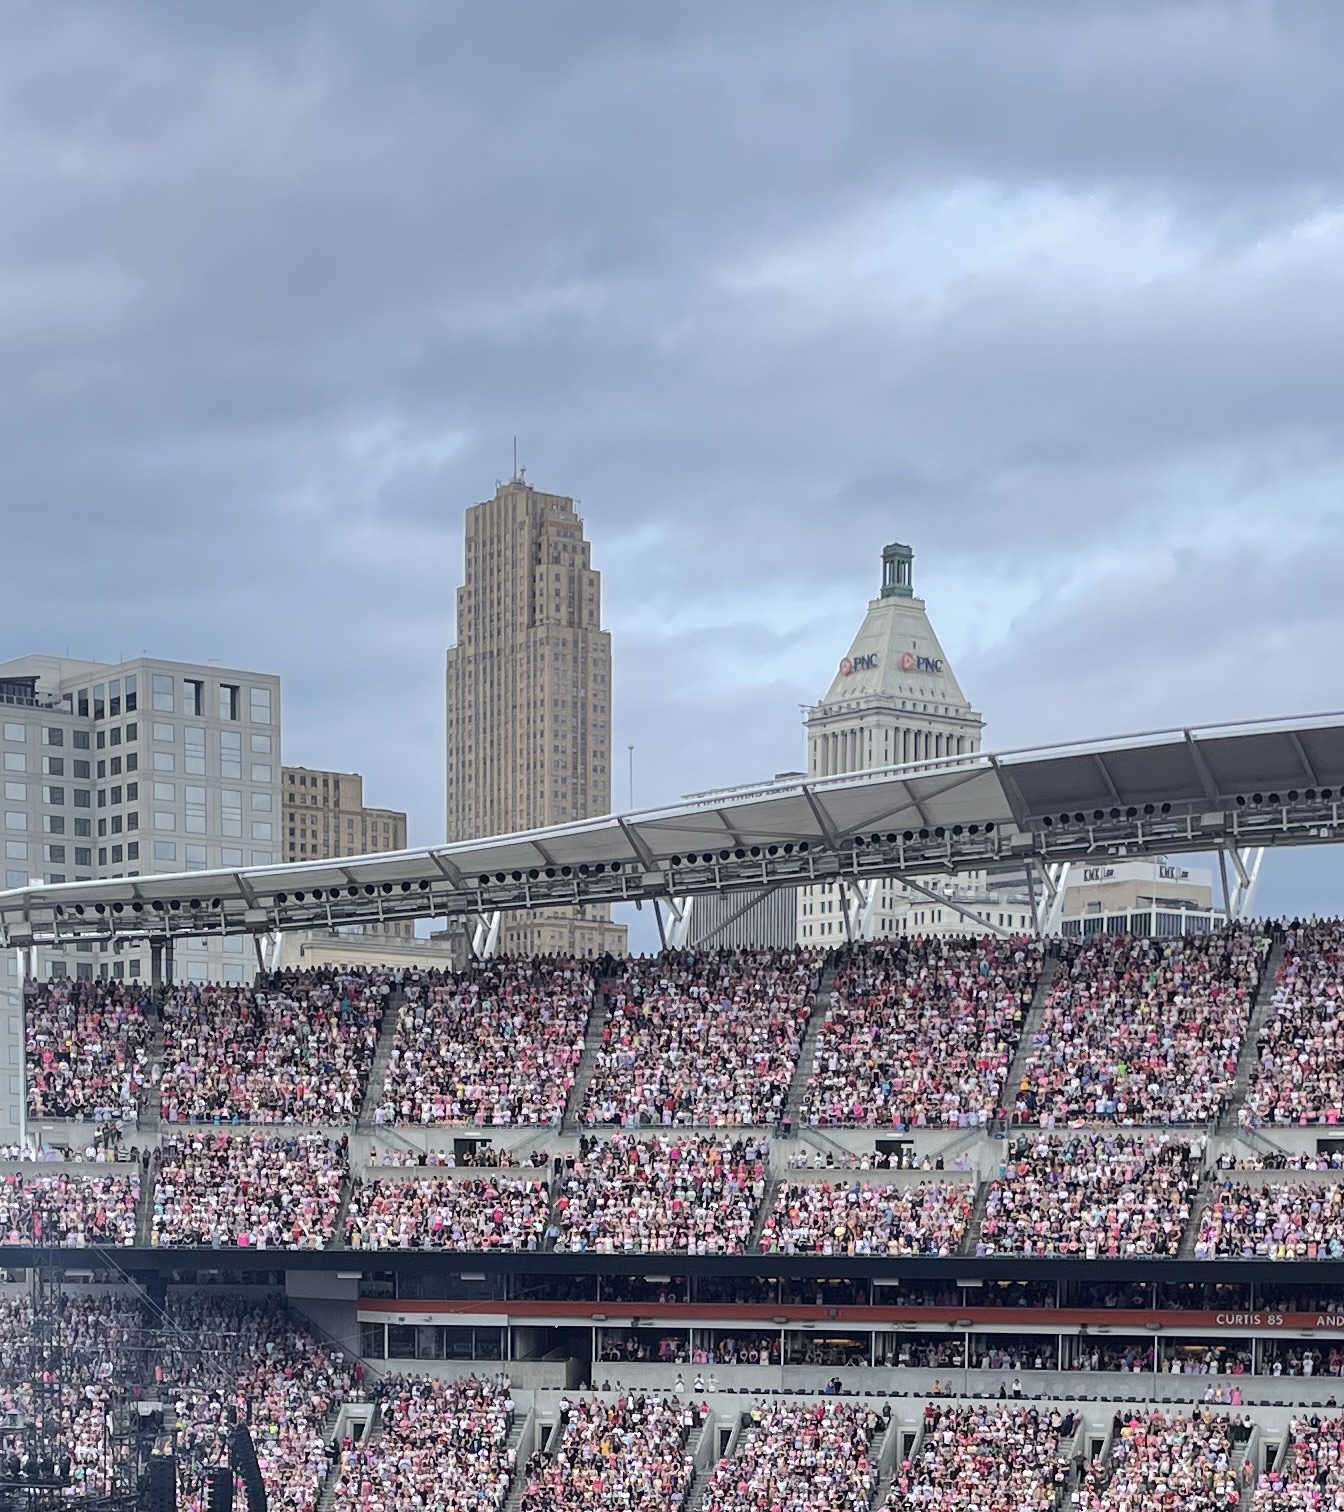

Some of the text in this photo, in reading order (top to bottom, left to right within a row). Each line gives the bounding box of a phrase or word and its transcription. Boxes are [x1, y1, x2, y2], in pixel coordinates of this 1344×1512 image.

[853, 653, 878, 671] PNC
[916, 656, 944, 673] PNC
[1215, 1313, 1284, 1326] CURTIS 85
